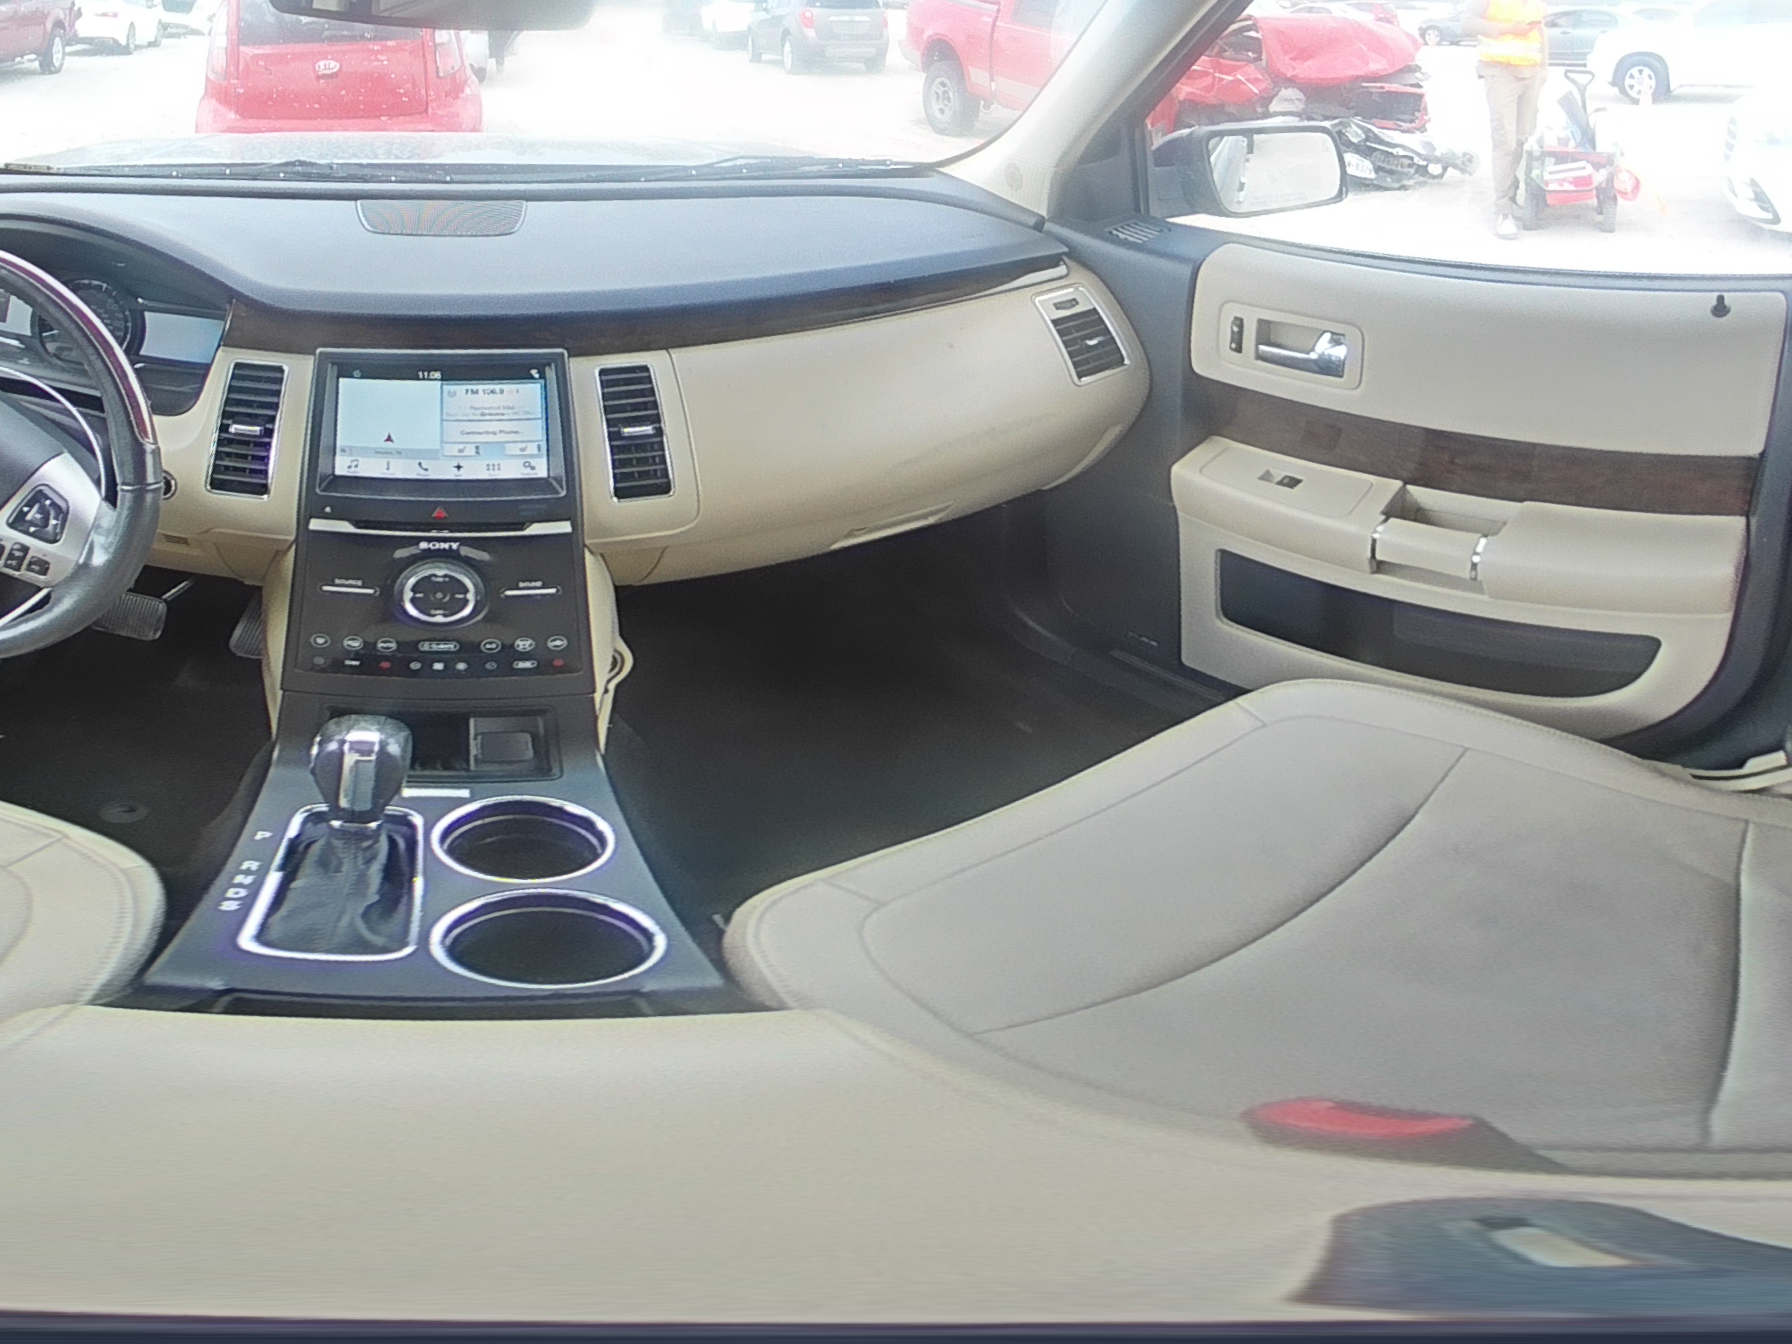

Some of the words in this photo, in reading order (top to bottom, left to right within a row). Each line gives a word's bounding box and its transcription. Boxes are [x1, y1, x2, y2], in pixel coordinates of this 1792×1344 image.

[418, 541, 460, 550] SONY
[254, 830, 274, 841] P
[239, 860, 261, 871] R
[232, 874, 256, 885] N
[225, 887, 248, 898] D
